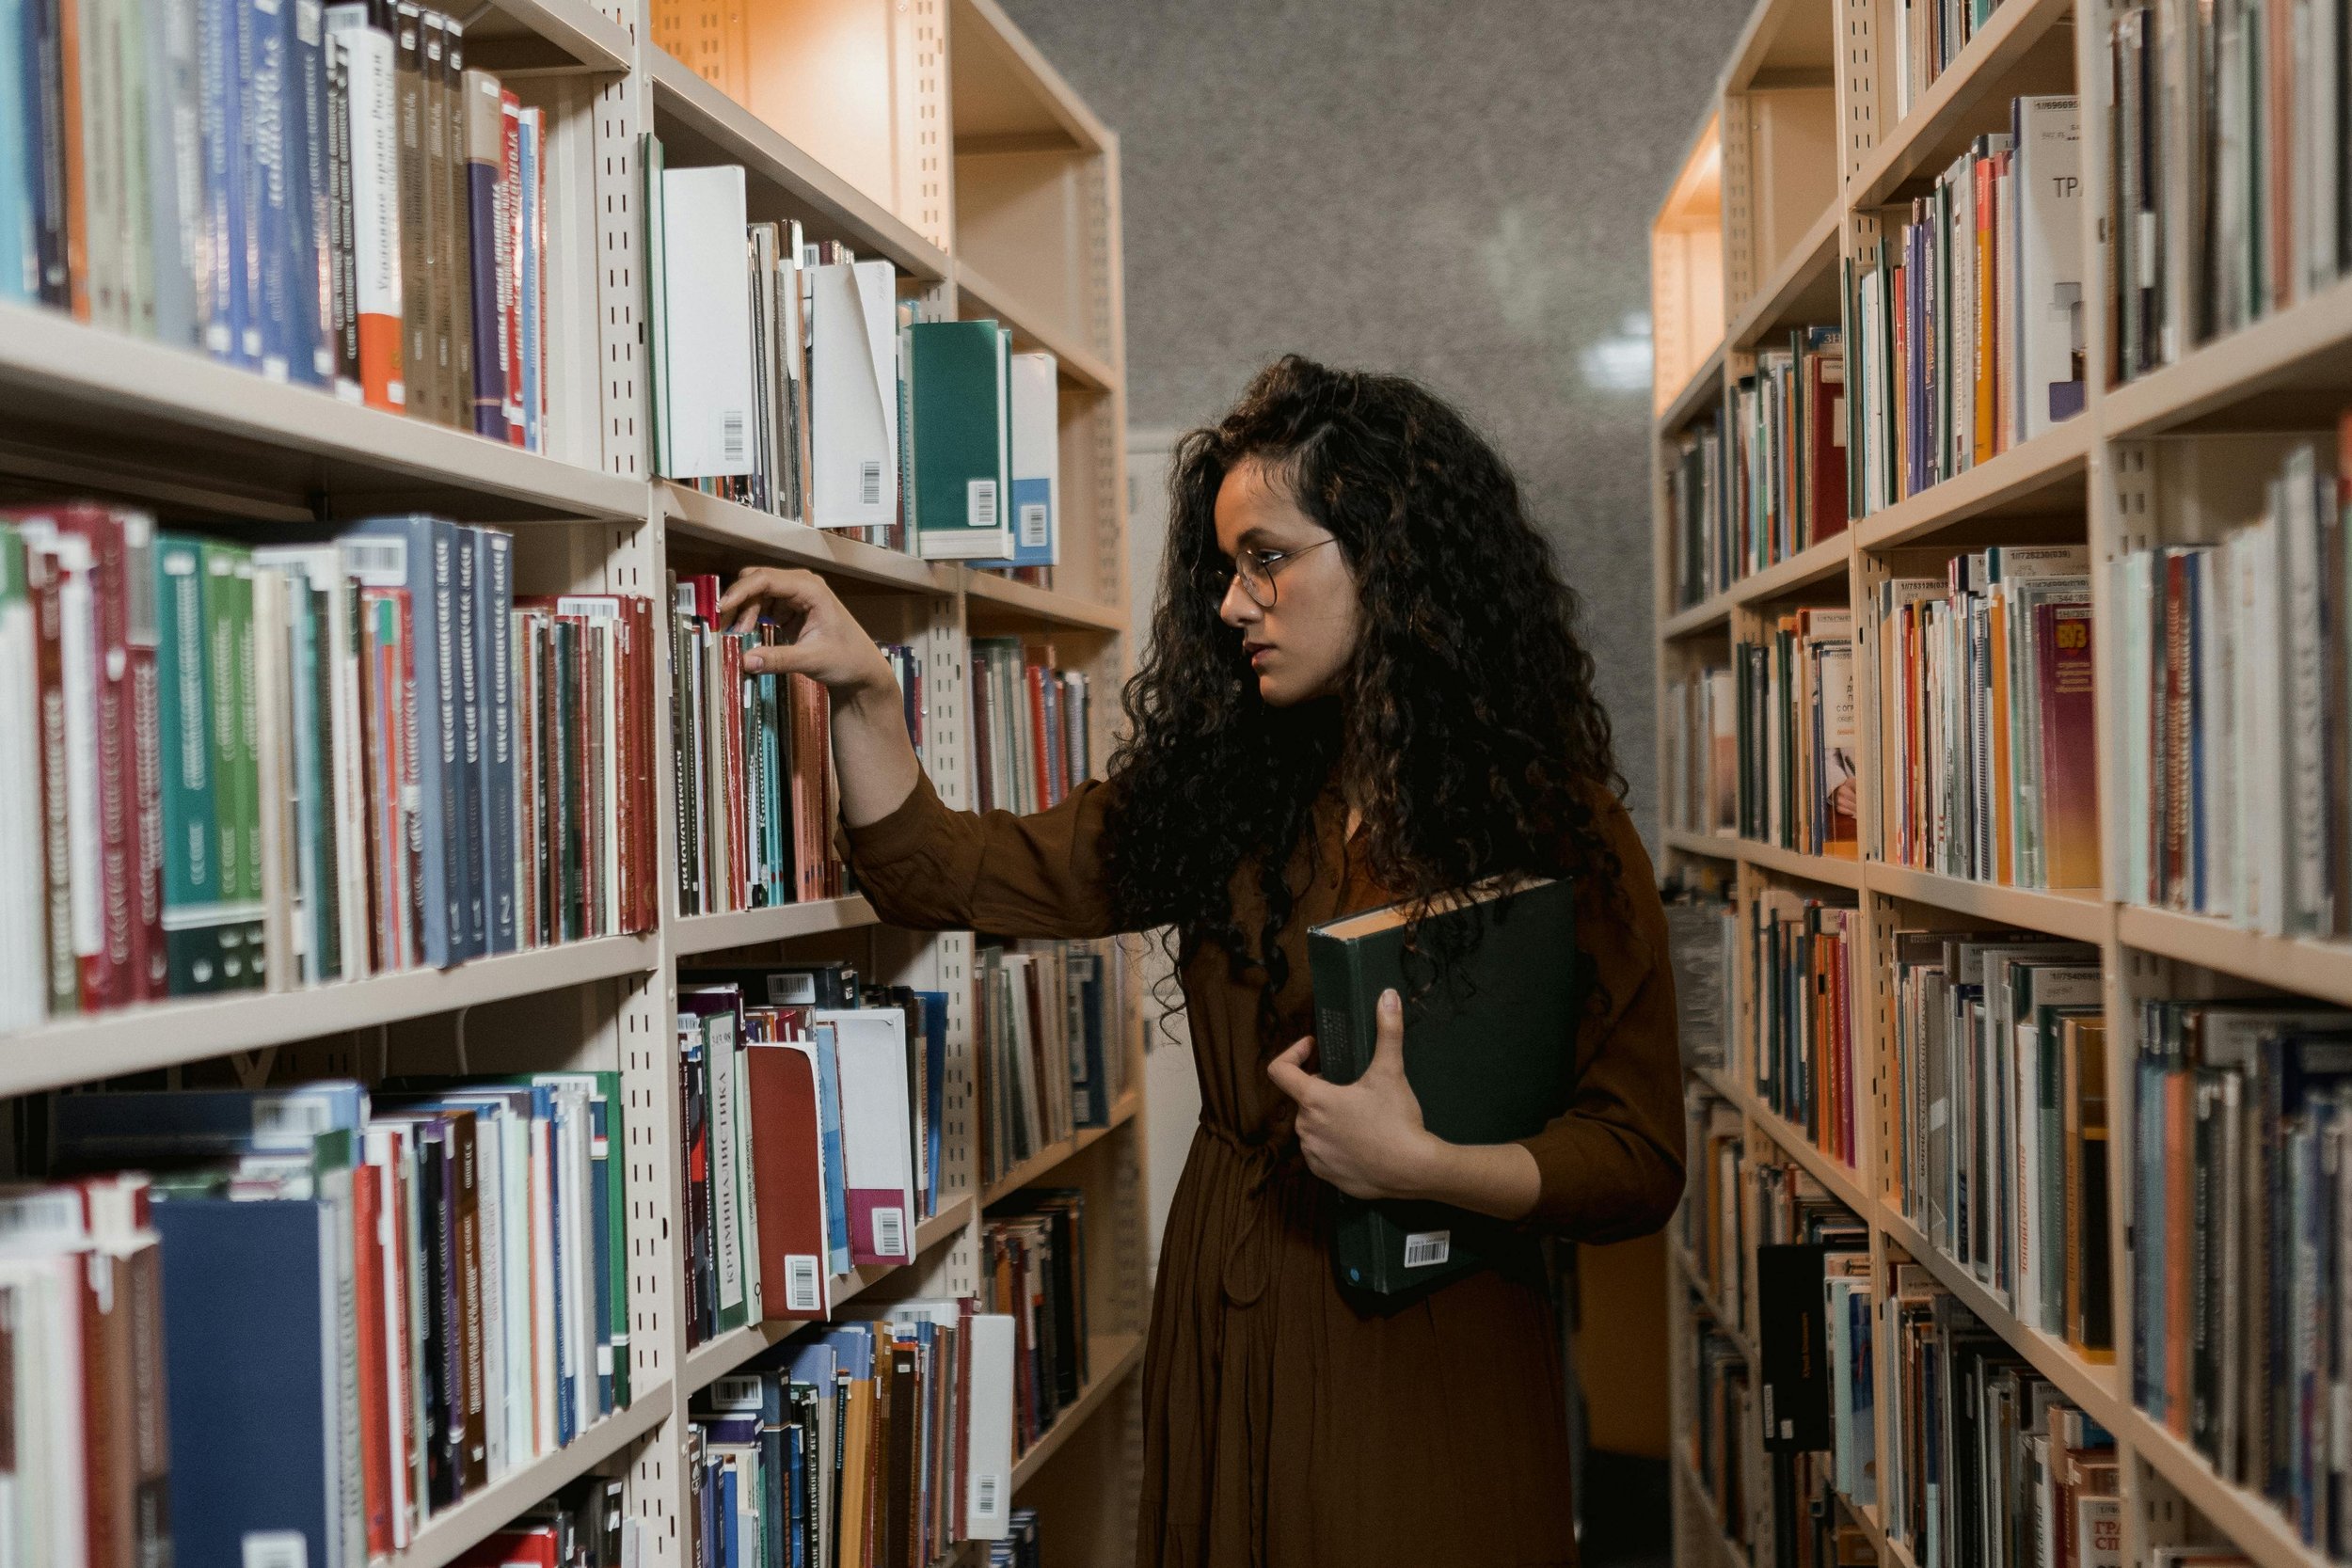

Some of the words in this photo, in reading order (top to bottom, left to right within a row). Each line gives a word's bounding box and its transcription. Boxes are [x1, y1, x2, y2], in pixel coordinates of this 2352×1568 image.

[2054, 177, 2084, 198] ТР
[718, 1070, 735, 1284] КРИМИНАЛИСТИКА
[2020, 1145, 2029, 1275] АЛЬТЕРНАТИВНОЕ
